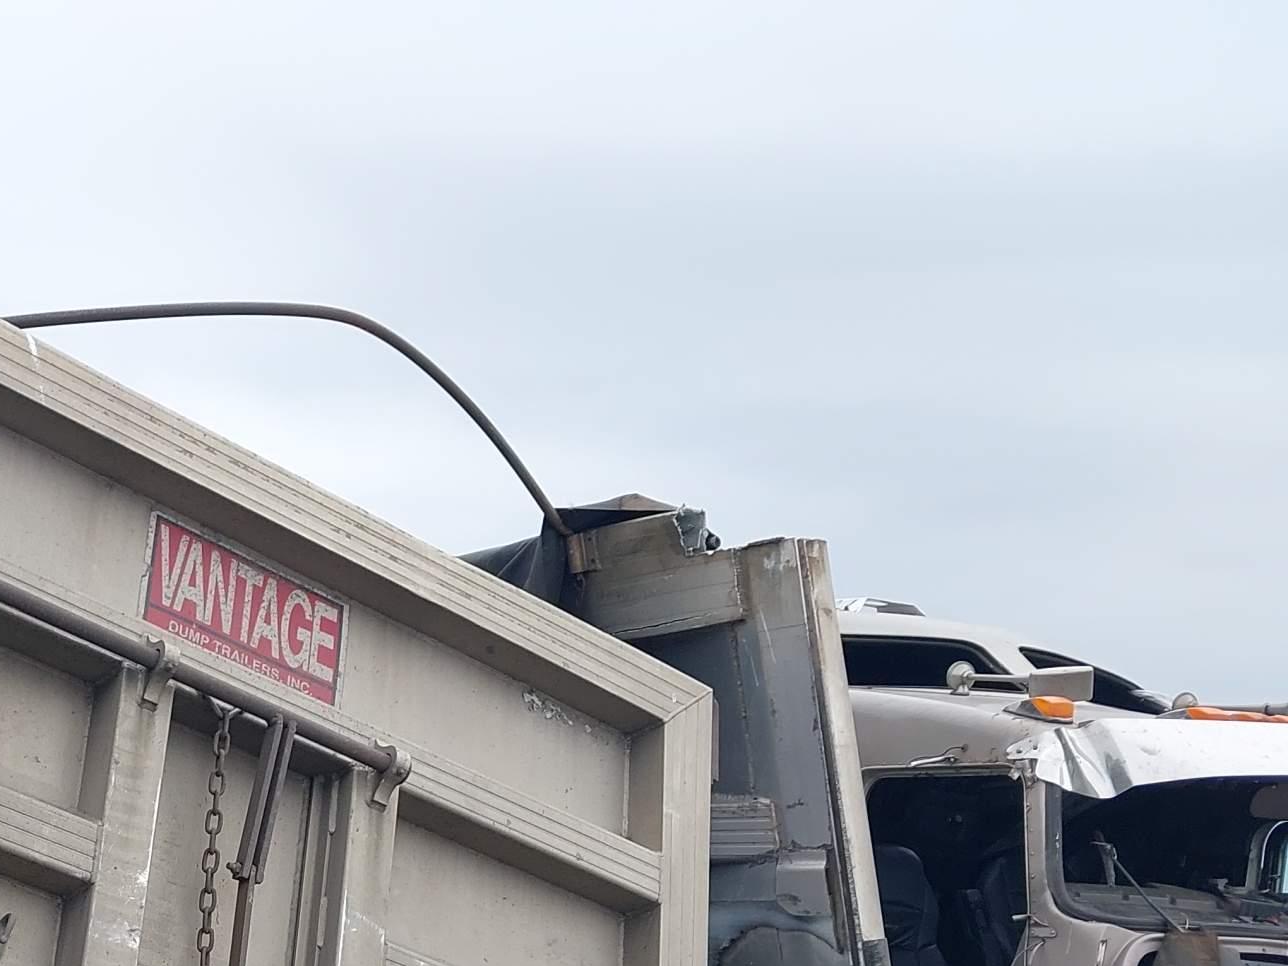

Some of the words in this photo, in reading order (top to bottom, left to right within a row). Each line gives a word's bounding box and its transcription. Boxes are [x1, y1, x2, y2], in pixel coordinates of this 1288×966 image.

[161, 524, 338, 682] VANTAGE
[168, 620, 209, 646] DUMP
[214, 639, 283, 684] TRAILERS,
[287, 676, 313, 695] INC.
